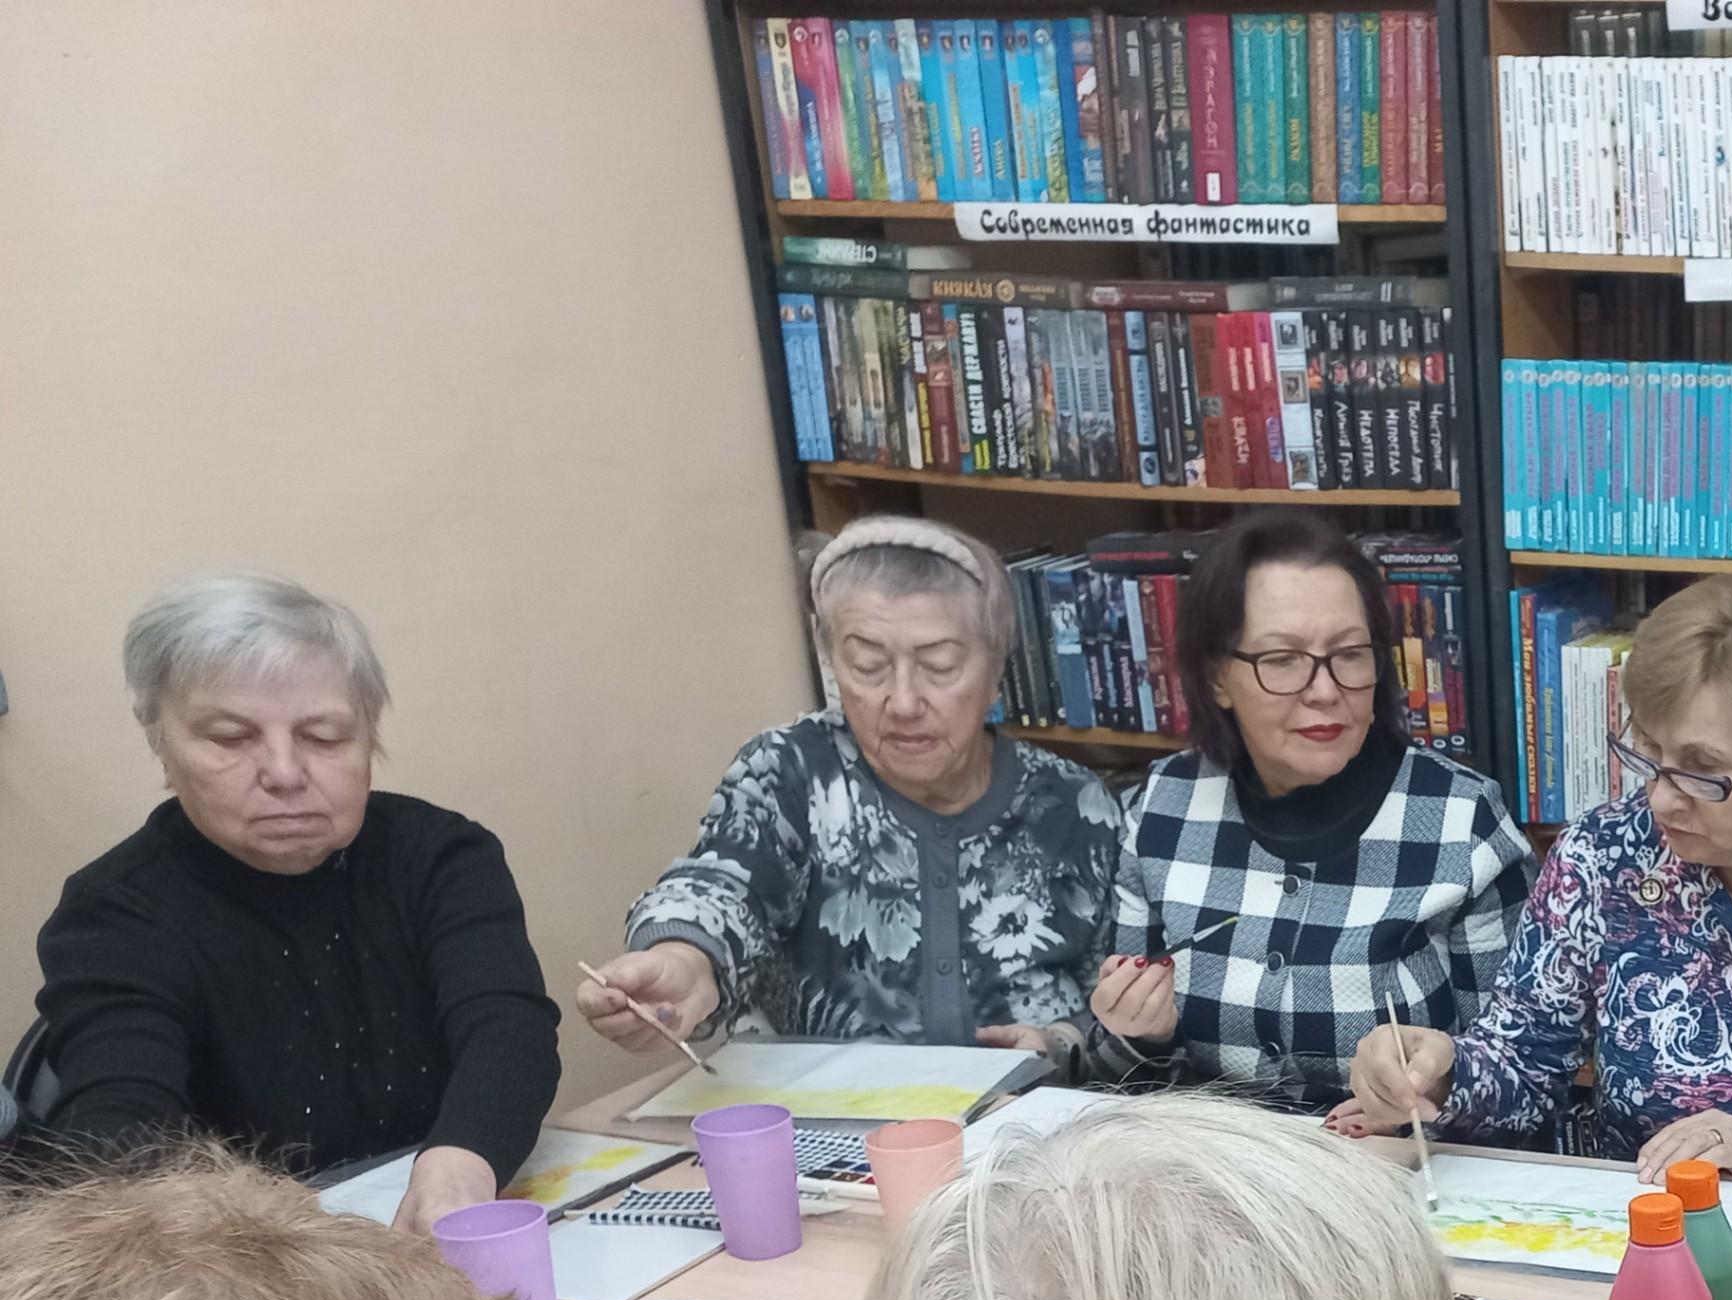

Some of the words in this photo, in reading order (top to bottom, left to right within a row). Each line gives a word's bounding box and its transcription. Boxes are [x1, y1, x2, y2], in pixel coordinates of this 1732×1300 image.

[980, 208, 1133, 240] Современная
[1146, 210, 1311, 240] фантастика
[1523, 637, 1533, 670] Мои
